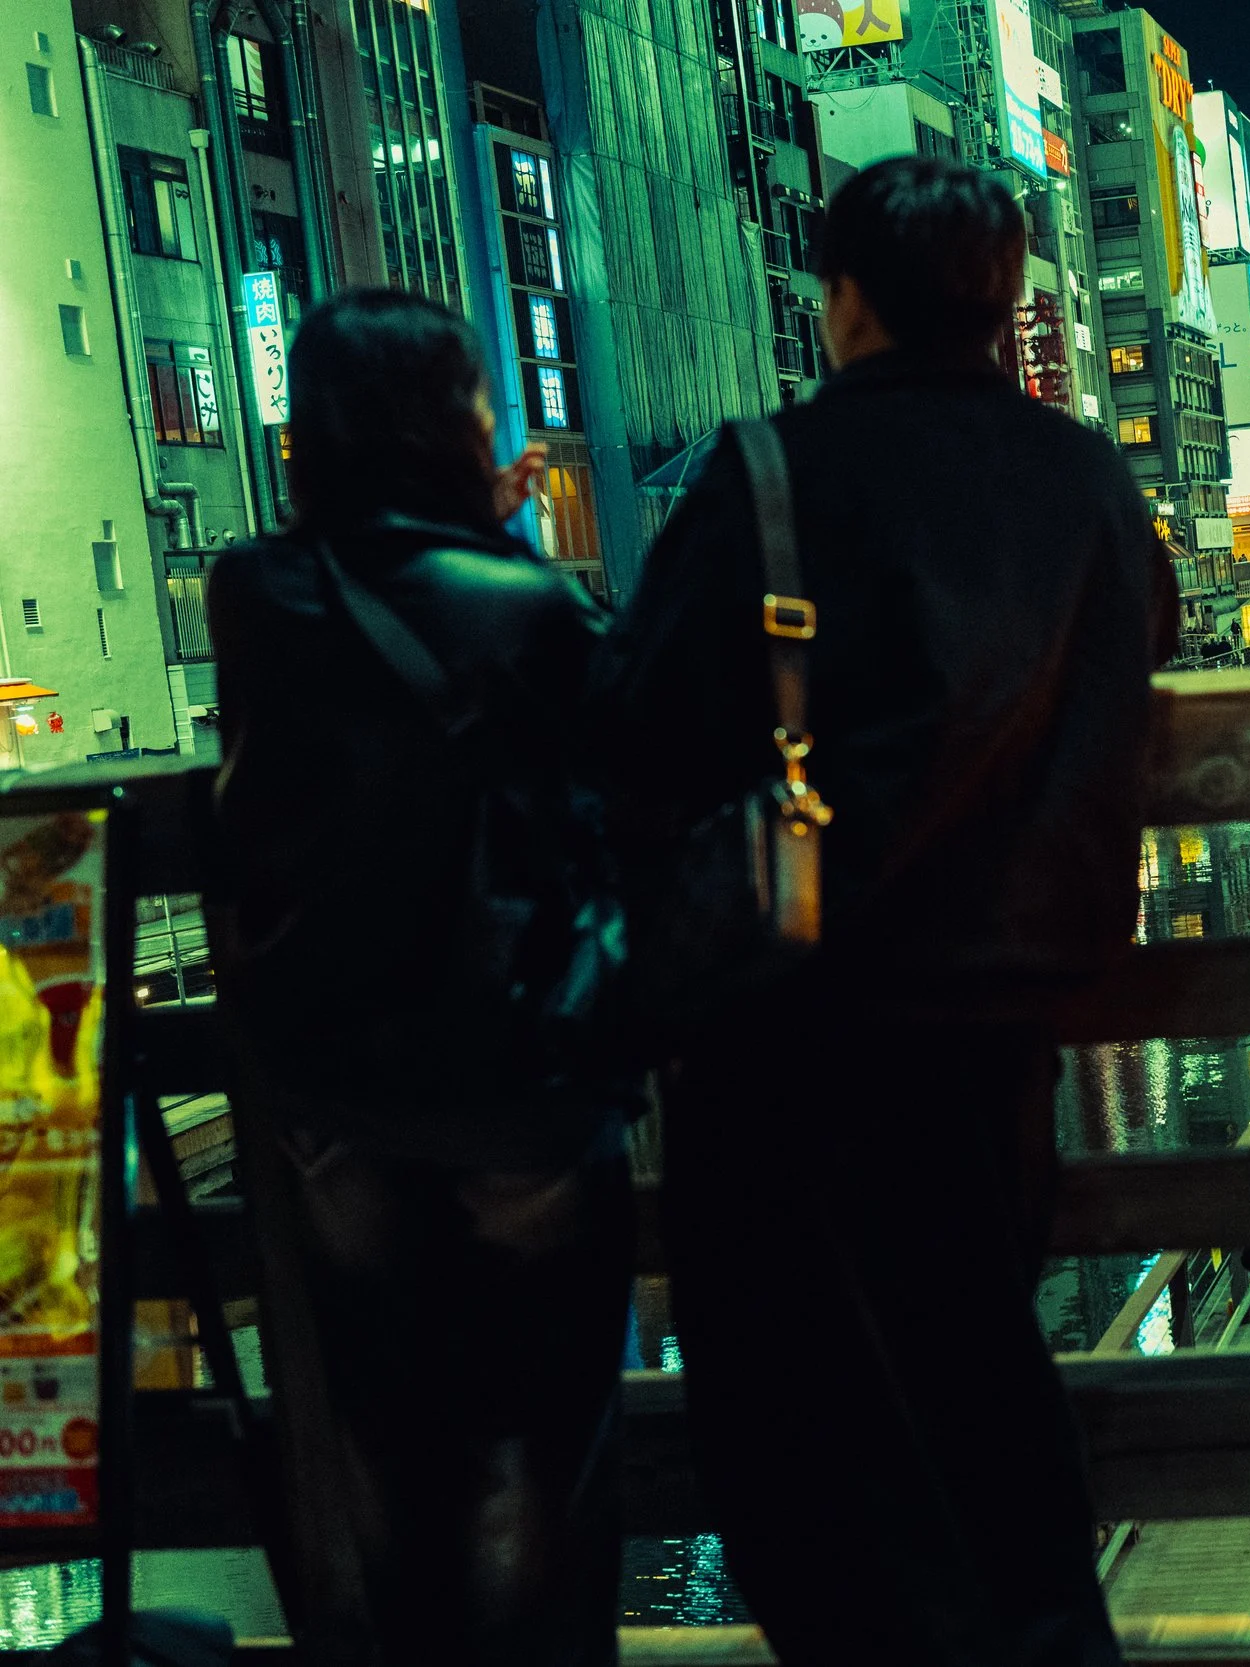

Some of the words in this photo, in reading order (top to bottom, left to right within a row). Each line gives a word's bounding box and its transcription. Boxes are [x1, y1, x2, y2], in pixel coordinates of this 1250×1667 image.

[1163, 35, 1181, 67] SUPER
[252, 277, 278, 325] 焼肉
[259, 328, 289, 419] いろりや
